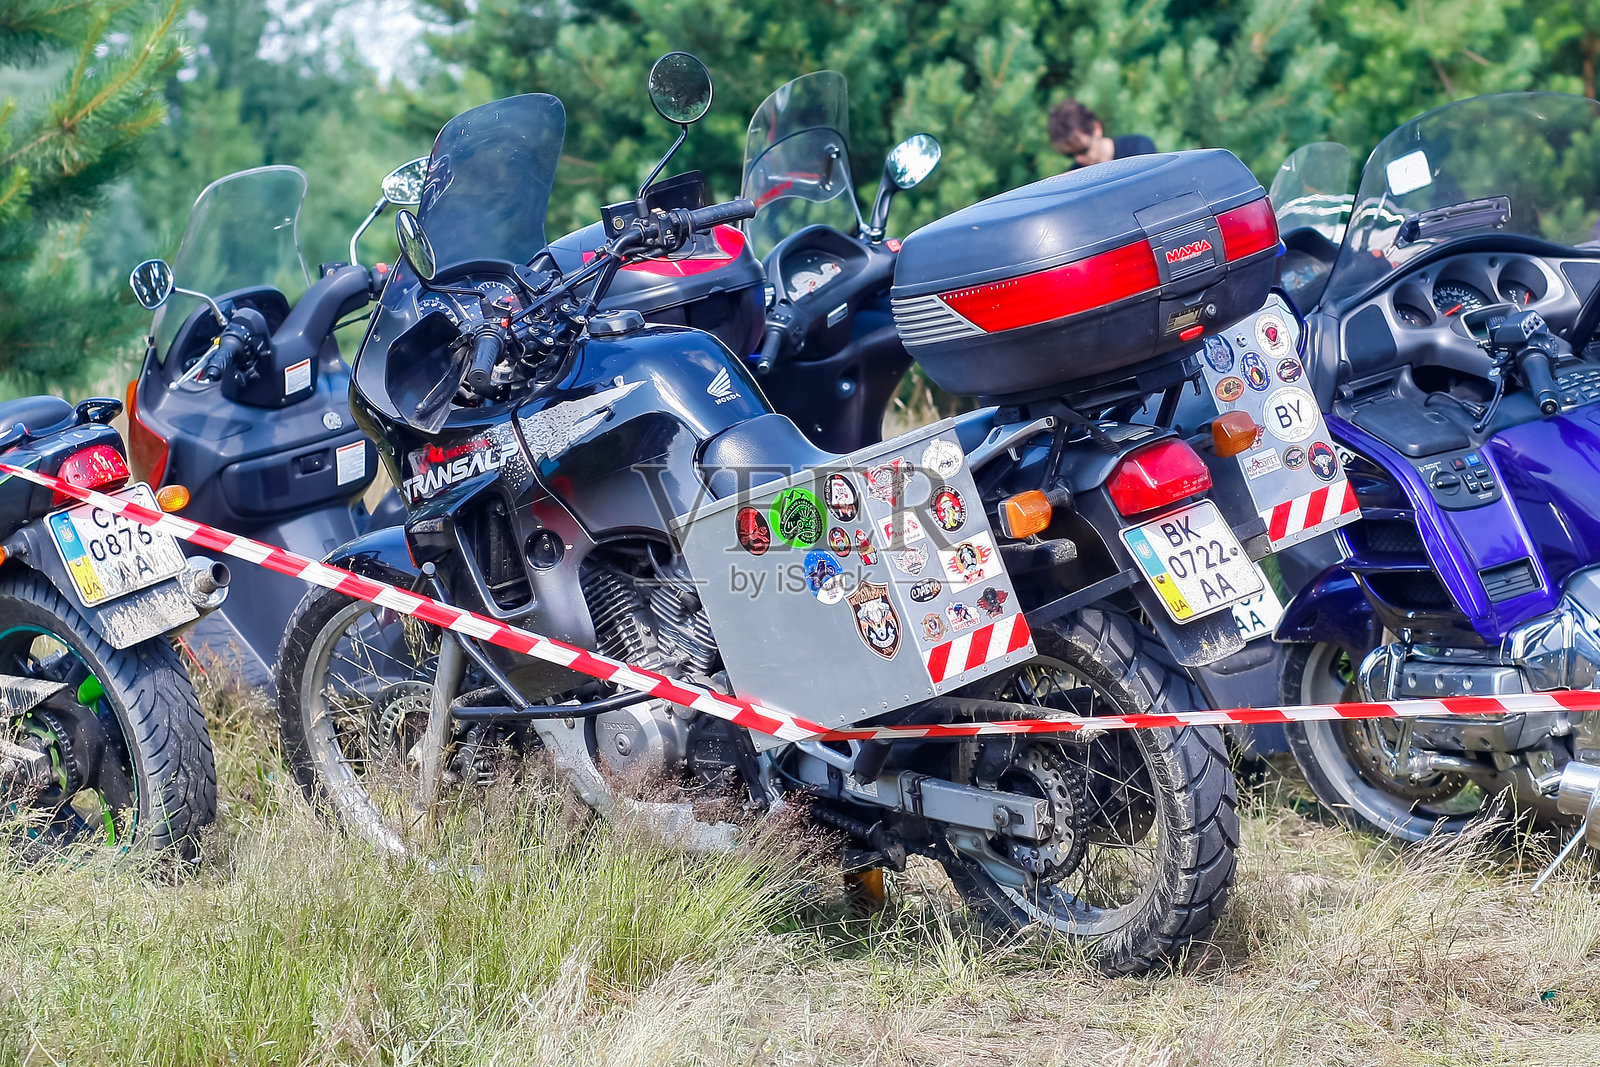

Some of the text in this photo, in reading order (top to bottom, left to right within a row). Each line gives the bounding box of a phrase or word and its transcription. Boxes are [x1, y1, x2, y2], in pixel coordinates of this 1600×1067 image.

[714, 392, 742, 405] HONDA
[1275, 399, 1302, 429] BY
[402, 441, 519, 504] TRANSALP
[90, 523, 152, 561] 0876
[1160, 516, 1201, 547] BK
[1168, 540, 1231, 578] 0722
[83, 576, 102, 595] UA
[1200, 572, 1237, 603] AA
[1170, 600, 1188, 612] UA
[602, 721, 637, 732] HONDA
